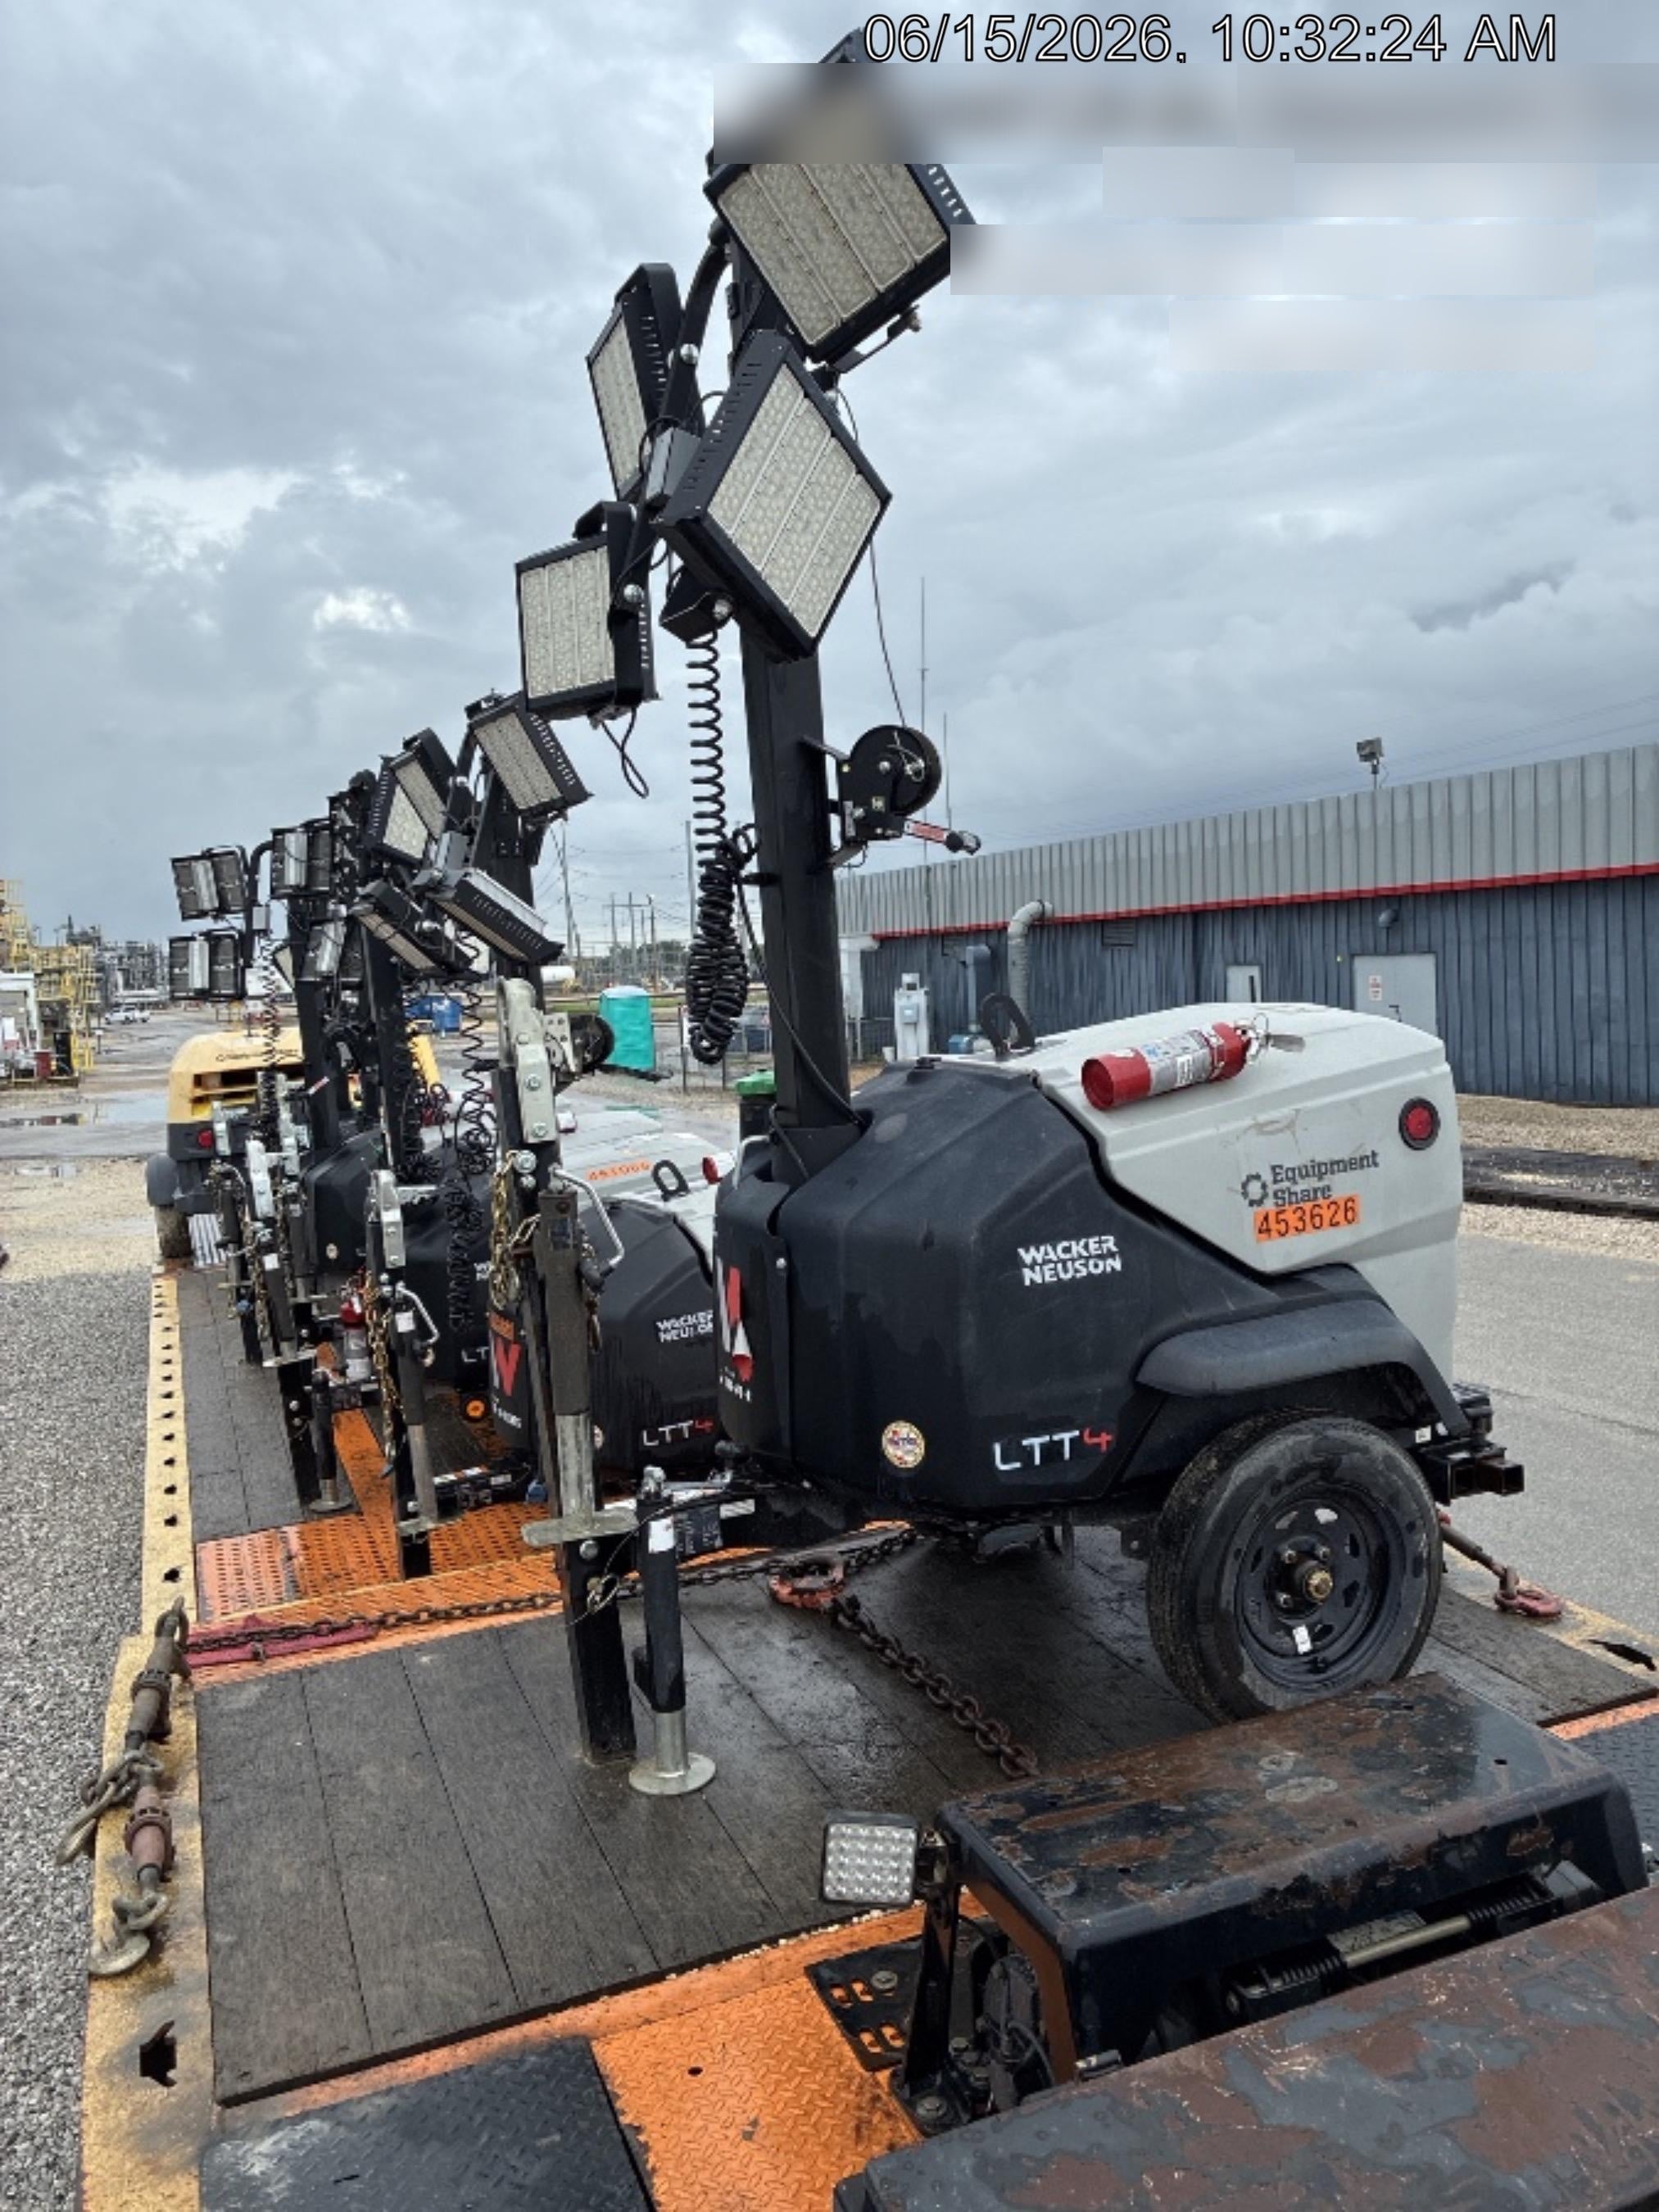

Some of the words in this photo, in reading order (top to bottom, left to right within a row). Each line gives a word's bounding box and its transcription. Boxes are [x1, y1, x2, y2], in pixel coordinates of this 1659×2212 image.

[1271, 1149, 1380, 1185] Equipment
[1272, 1184, 1333, 1208] Share
[1258, 1197, 1358, 1240] 453626
[1018, 1235, 1119, 1266] WACKER
[1022, 1254, 1122, 1287] NEUSON
[642, 1420, 714, 1447] LTT4
[993, 1427, 1113, 1471] LTT4
